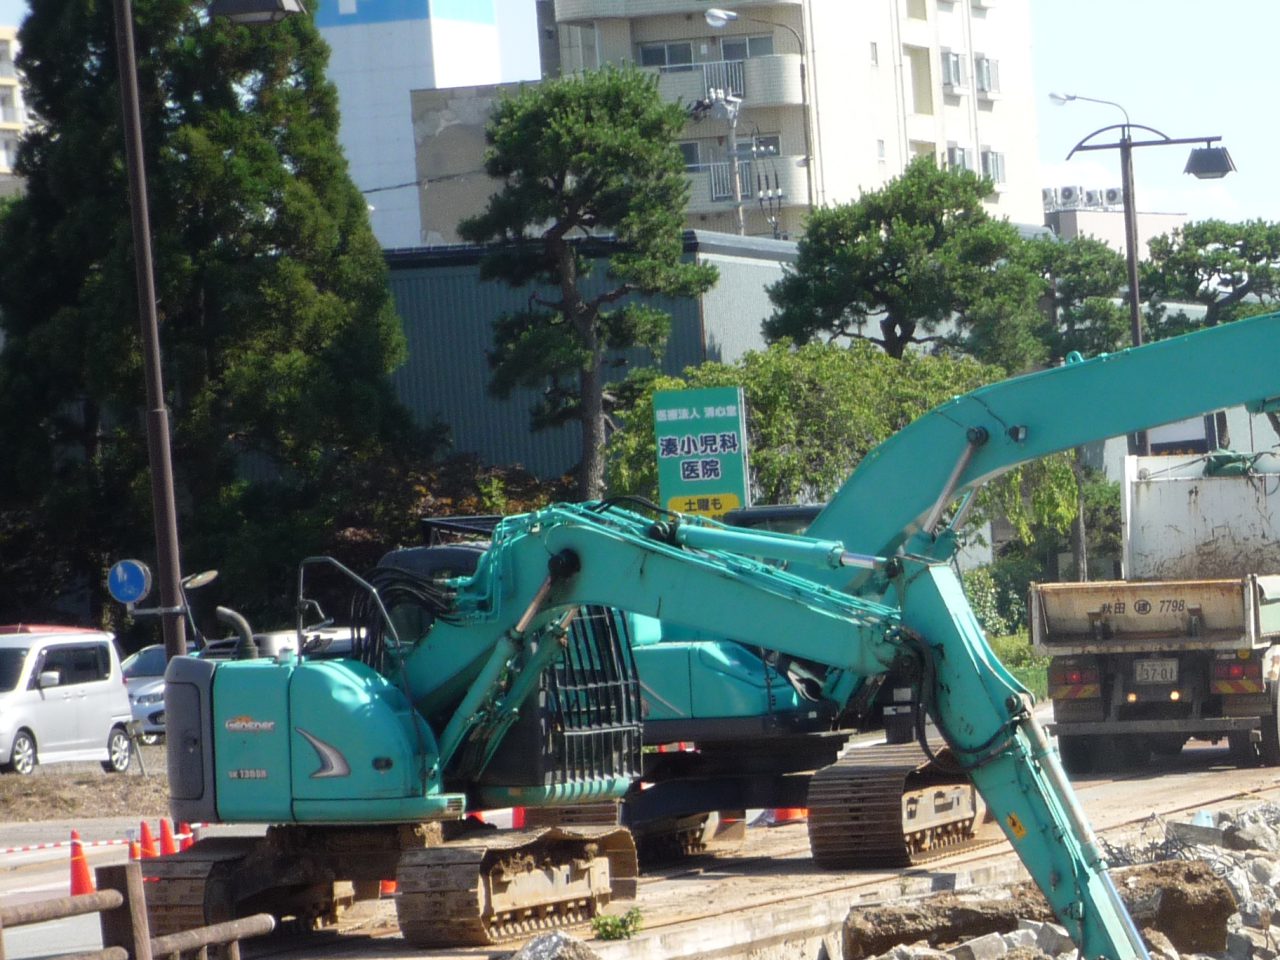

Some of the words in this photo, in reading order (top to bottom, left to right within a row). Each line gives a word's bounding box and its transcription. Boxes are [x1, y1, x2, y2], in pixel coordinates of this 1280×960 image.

[660, 432, 738, 458] 湊小児科
[681, 459, 721, 481] 医院
[1159, 599, 1185, 613] 7798
